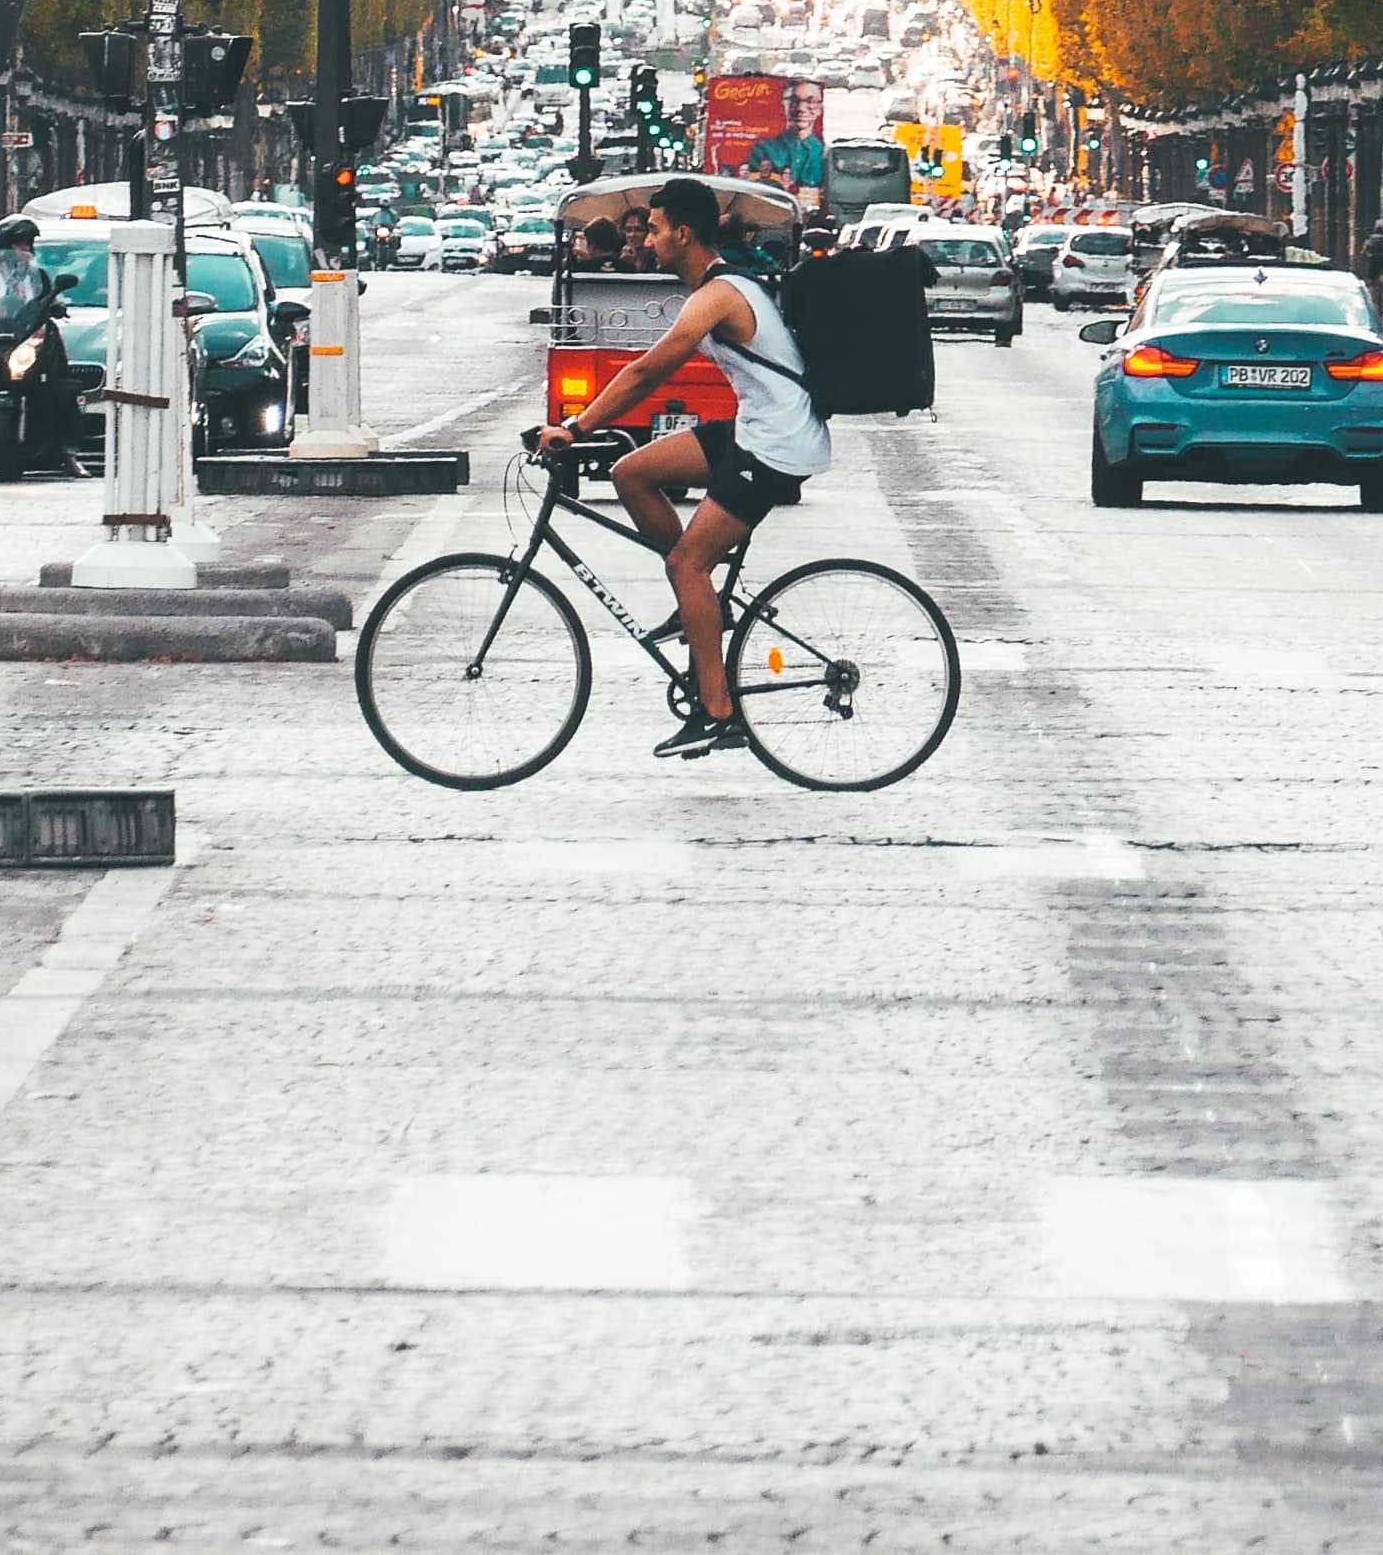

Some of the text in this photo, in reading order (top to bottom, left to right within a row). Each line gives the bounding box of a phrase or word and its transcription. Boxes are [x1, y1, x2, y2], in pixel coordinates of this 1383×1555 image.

[1229, 367, 1308, 384] PB VR 202
